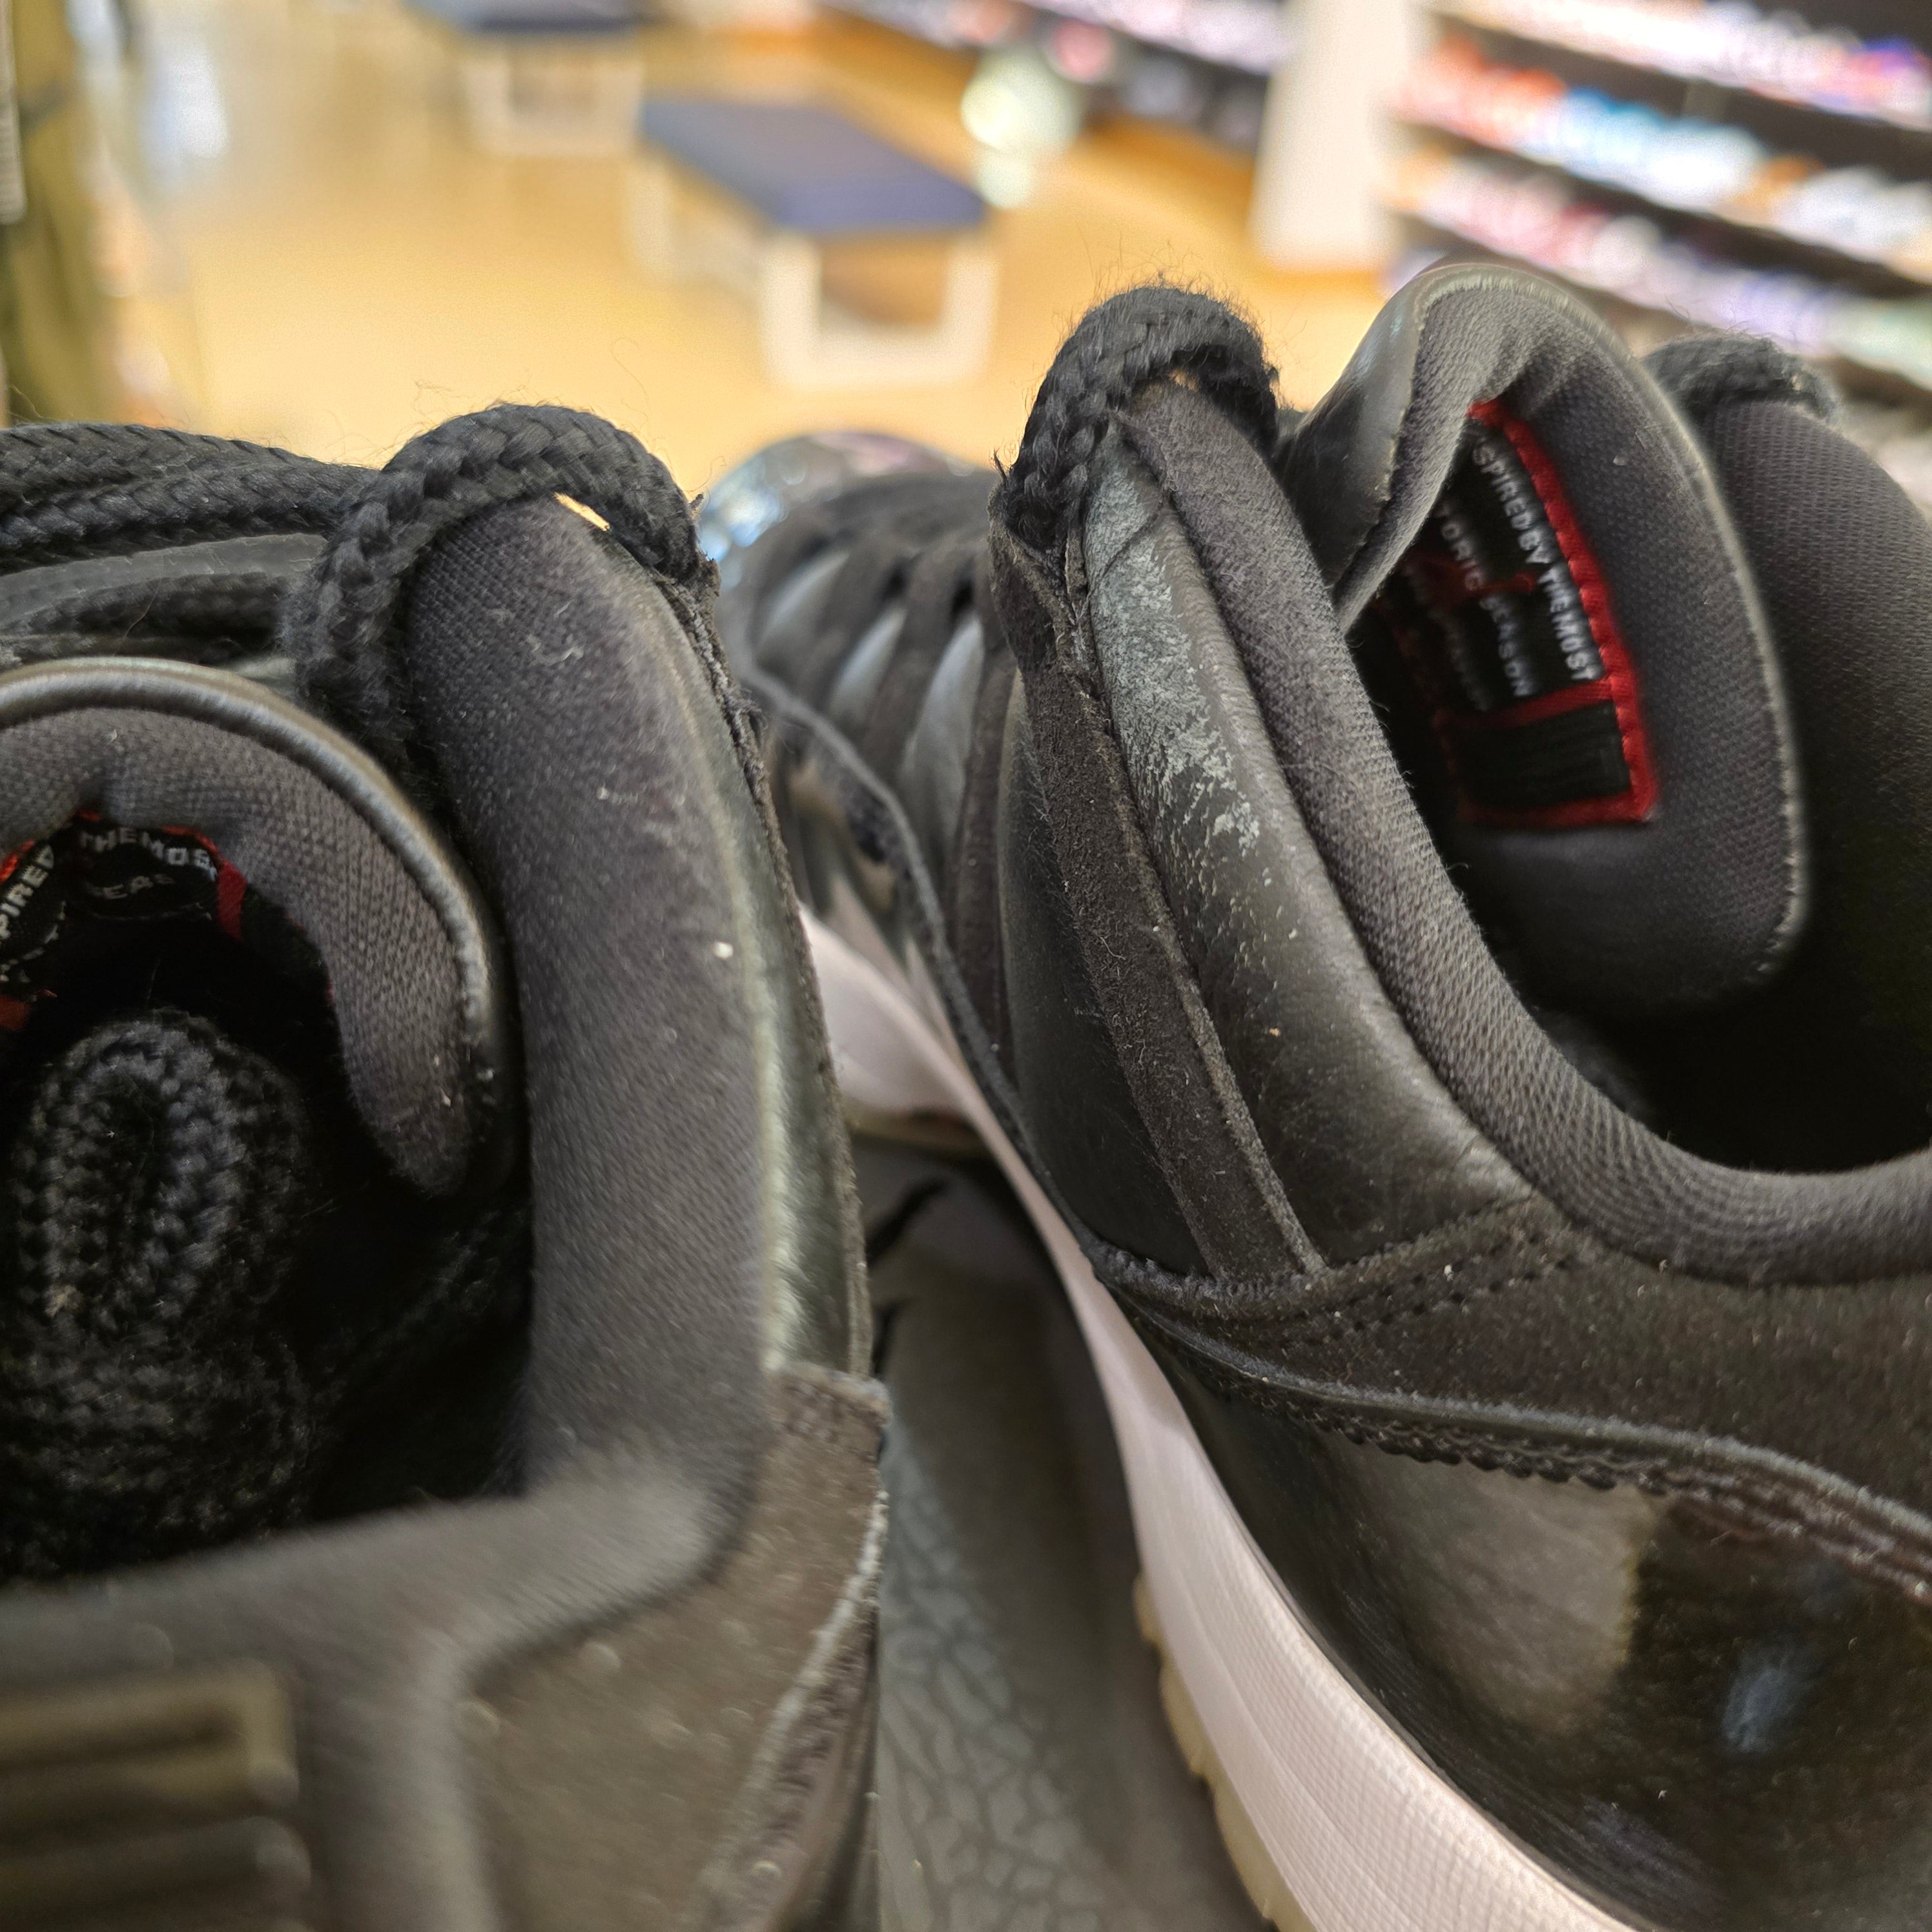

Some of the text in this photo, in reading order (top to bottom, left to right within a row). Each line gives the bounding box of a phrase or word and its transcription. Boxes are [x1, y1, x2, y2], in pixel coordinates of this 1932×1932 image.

[1471, 437, 1600, 681] SPIRED BY THE MOST
[0, 843, 54, 947] PIRED
